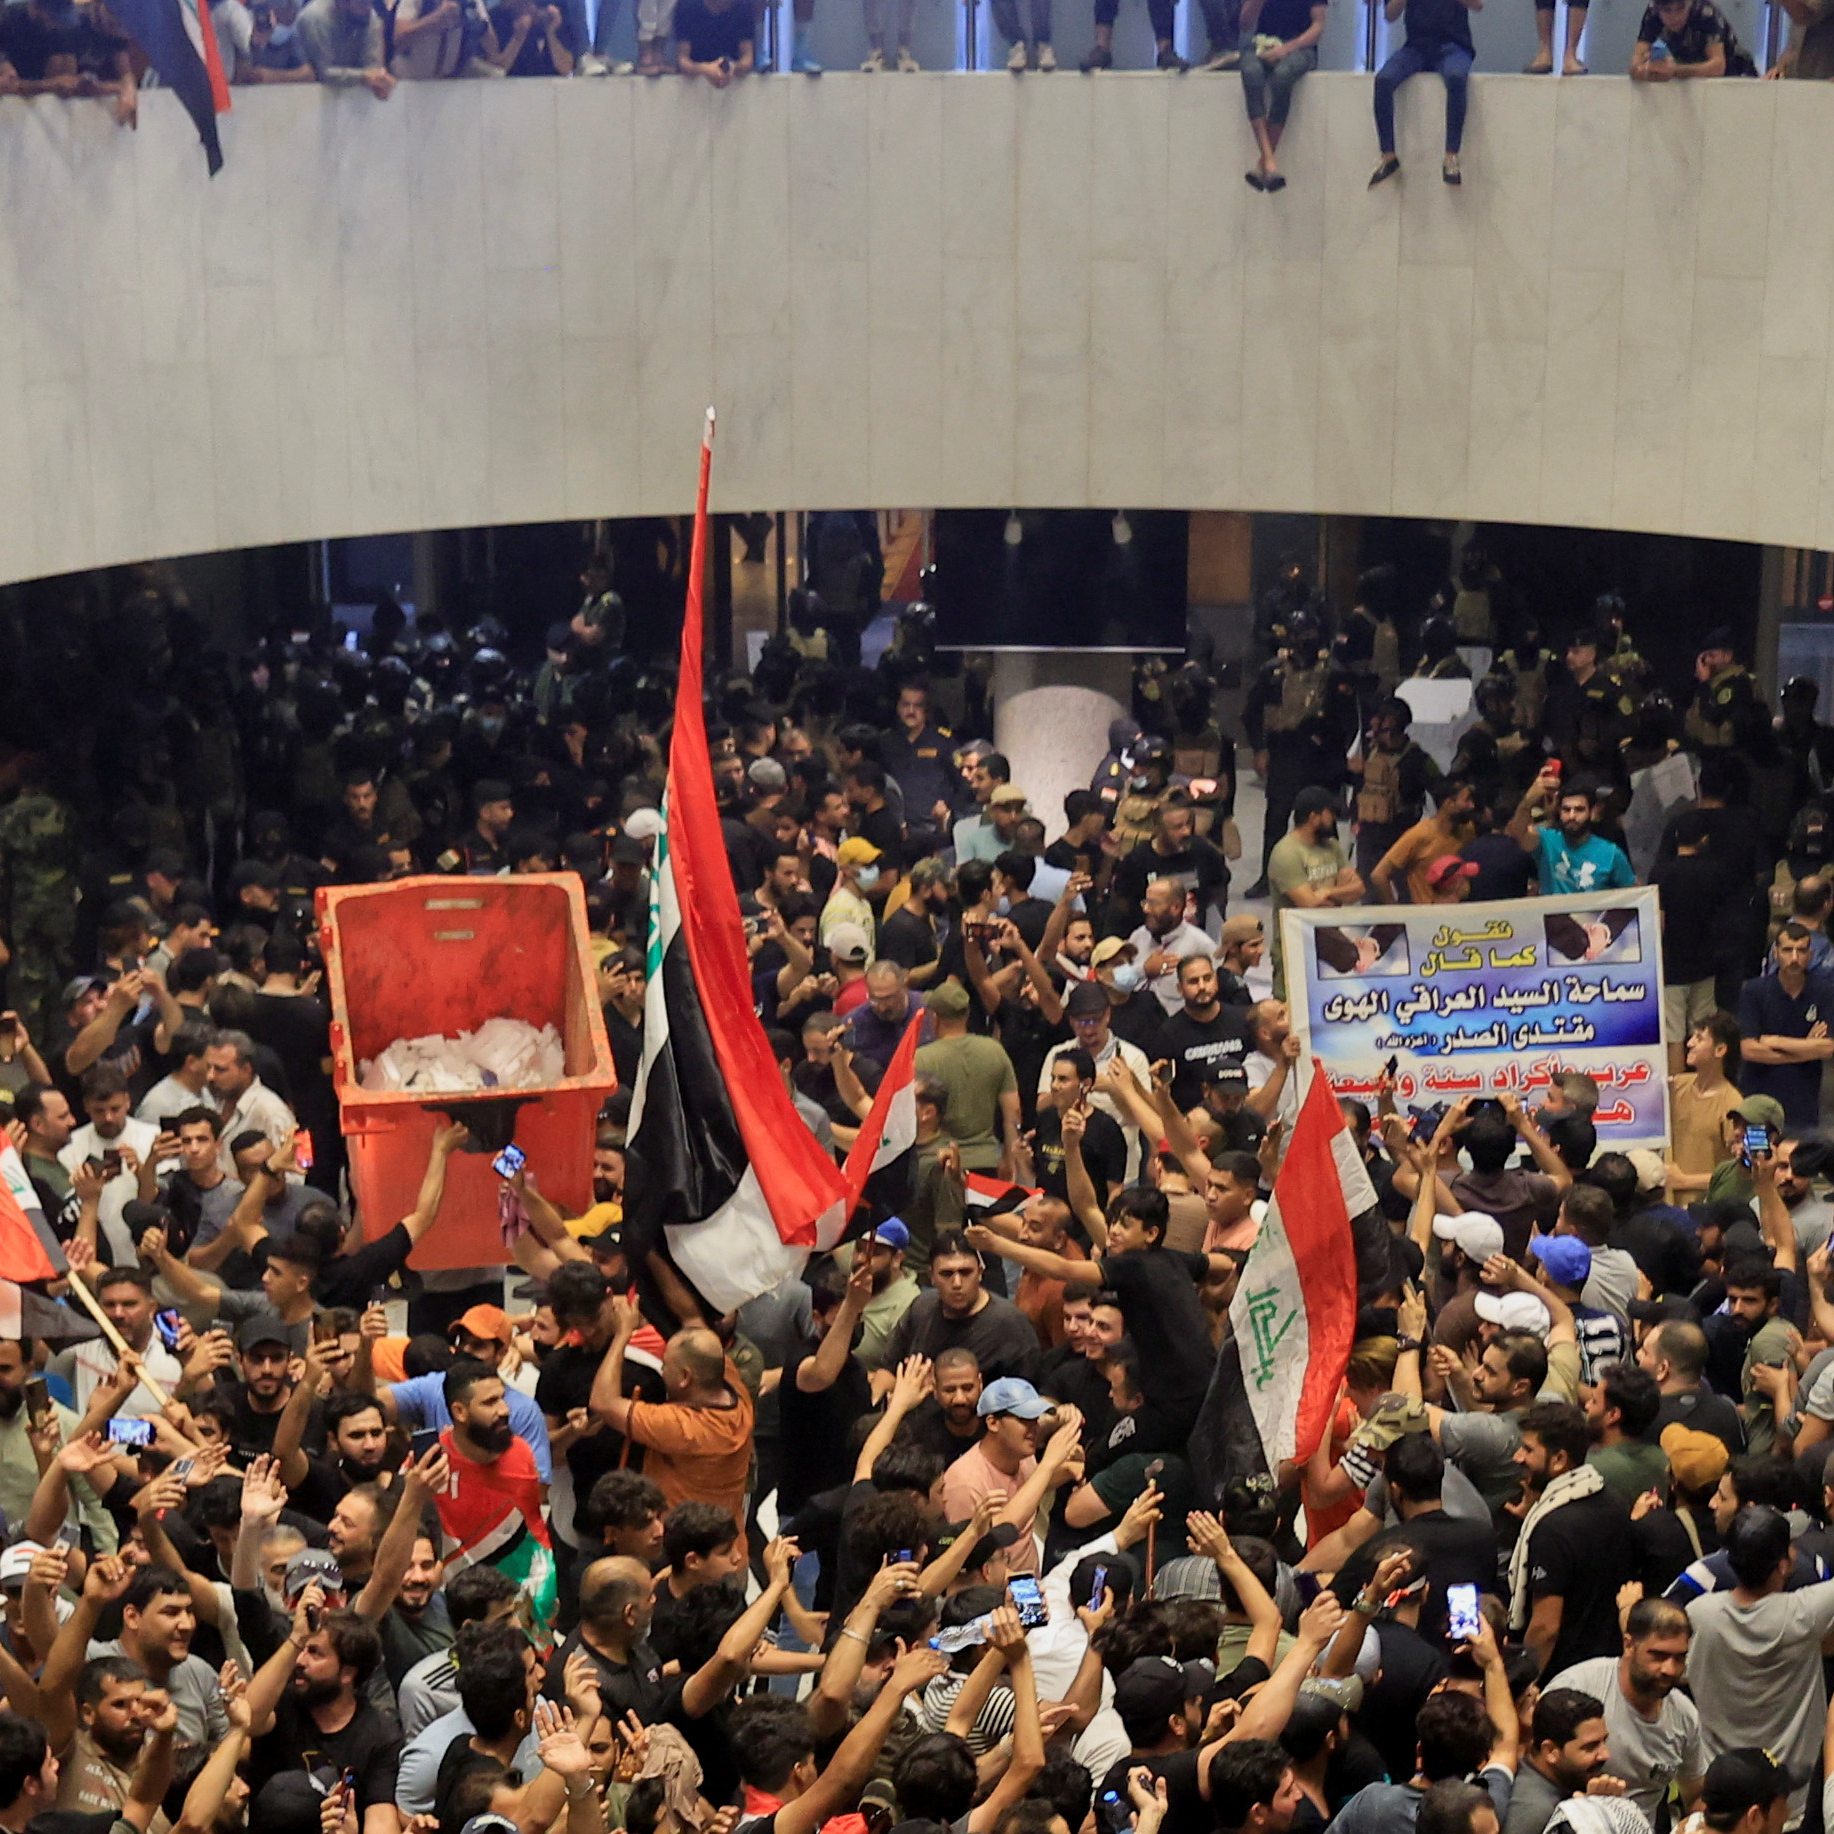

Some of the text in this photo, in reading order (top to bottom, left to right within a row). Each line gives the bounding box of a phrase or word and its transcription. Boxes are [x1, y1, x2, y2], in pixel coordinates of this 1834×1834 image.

[1433, 921, 1513, 948] نقول
[1419, 945, 1536, 977] كما قال
[1324, 977, 1646, 1022] سماحة السيد العراقي الهوى
[1441, 1022, 1506, 1054] الصدر
[1512, 1015, 1596, 1050] مقتدى
[1424, 1063, 1482, 1090] سنة
[1588, 1059, 1650, 1090] عرب
